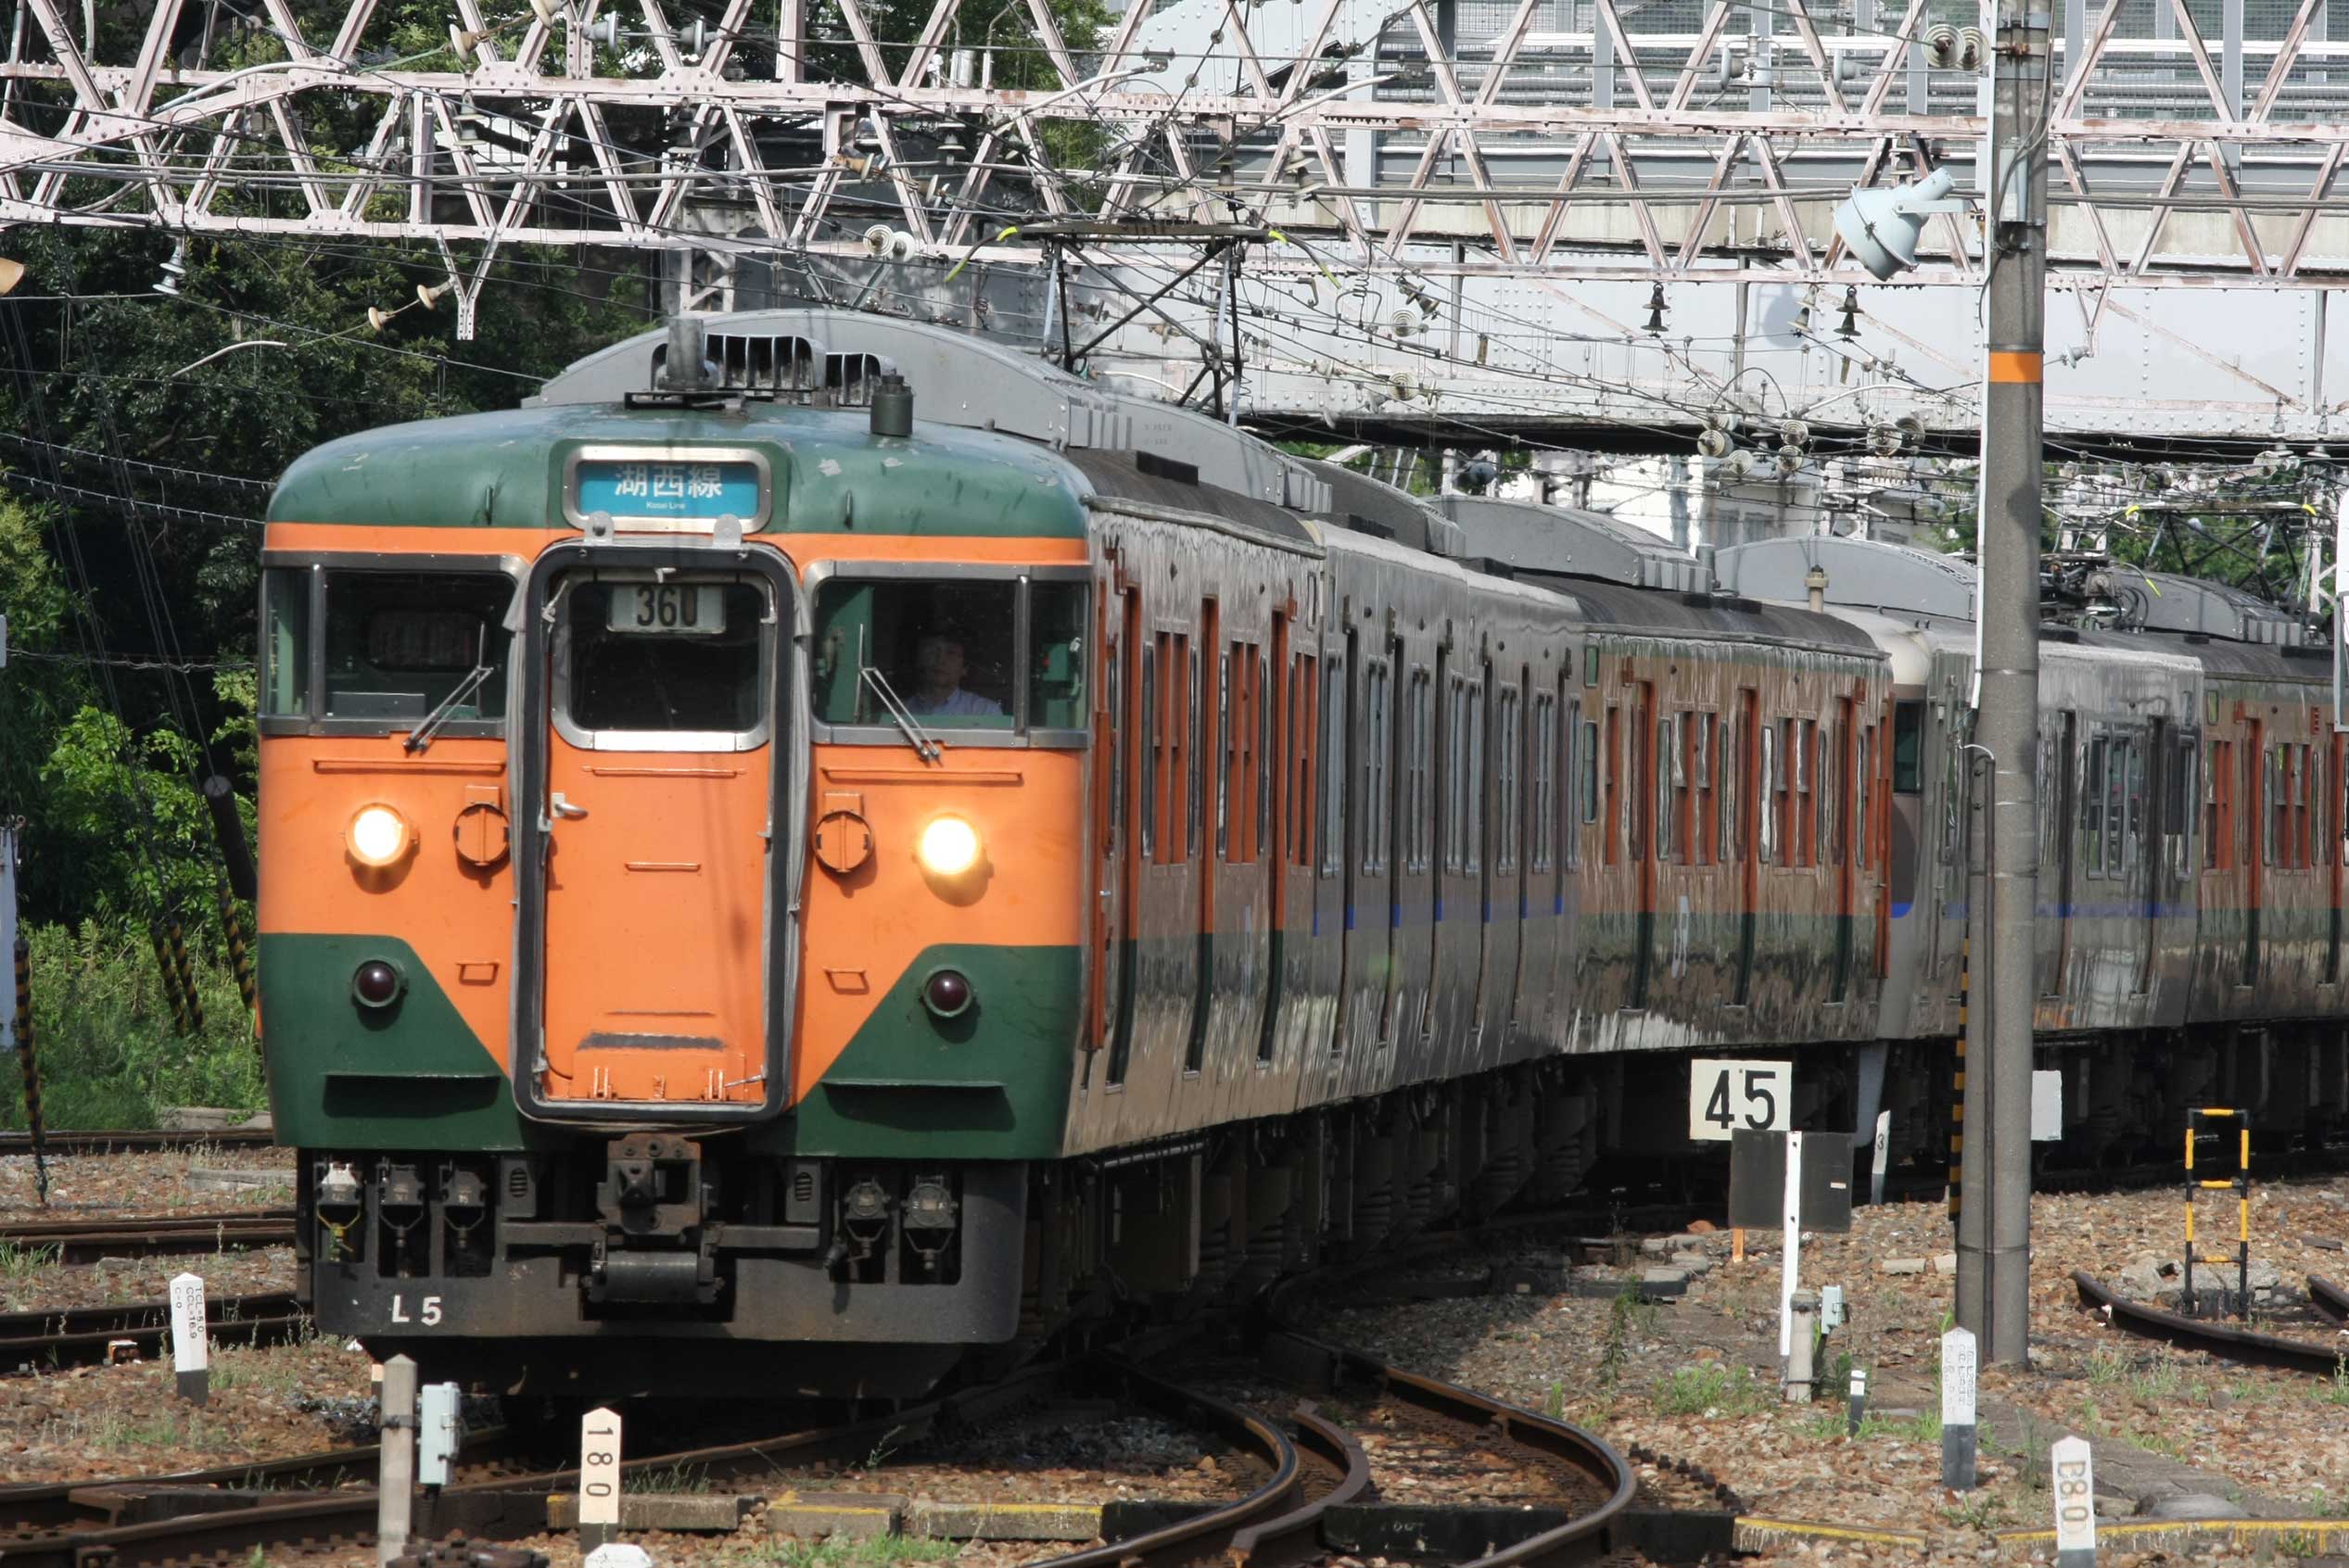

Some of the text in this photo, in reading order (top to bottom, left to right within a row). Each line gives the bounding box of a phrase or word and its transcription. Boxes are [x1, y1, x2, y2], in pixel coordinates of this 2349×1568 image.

[615, 463, 723, 499] 湖西線
[637, 585, 698, 626] 360
[1705, 1069, 1776, 1131] 45
[1876, 1133, 1885, 1151] 3
[586, 1427, 614, 1497] 180
